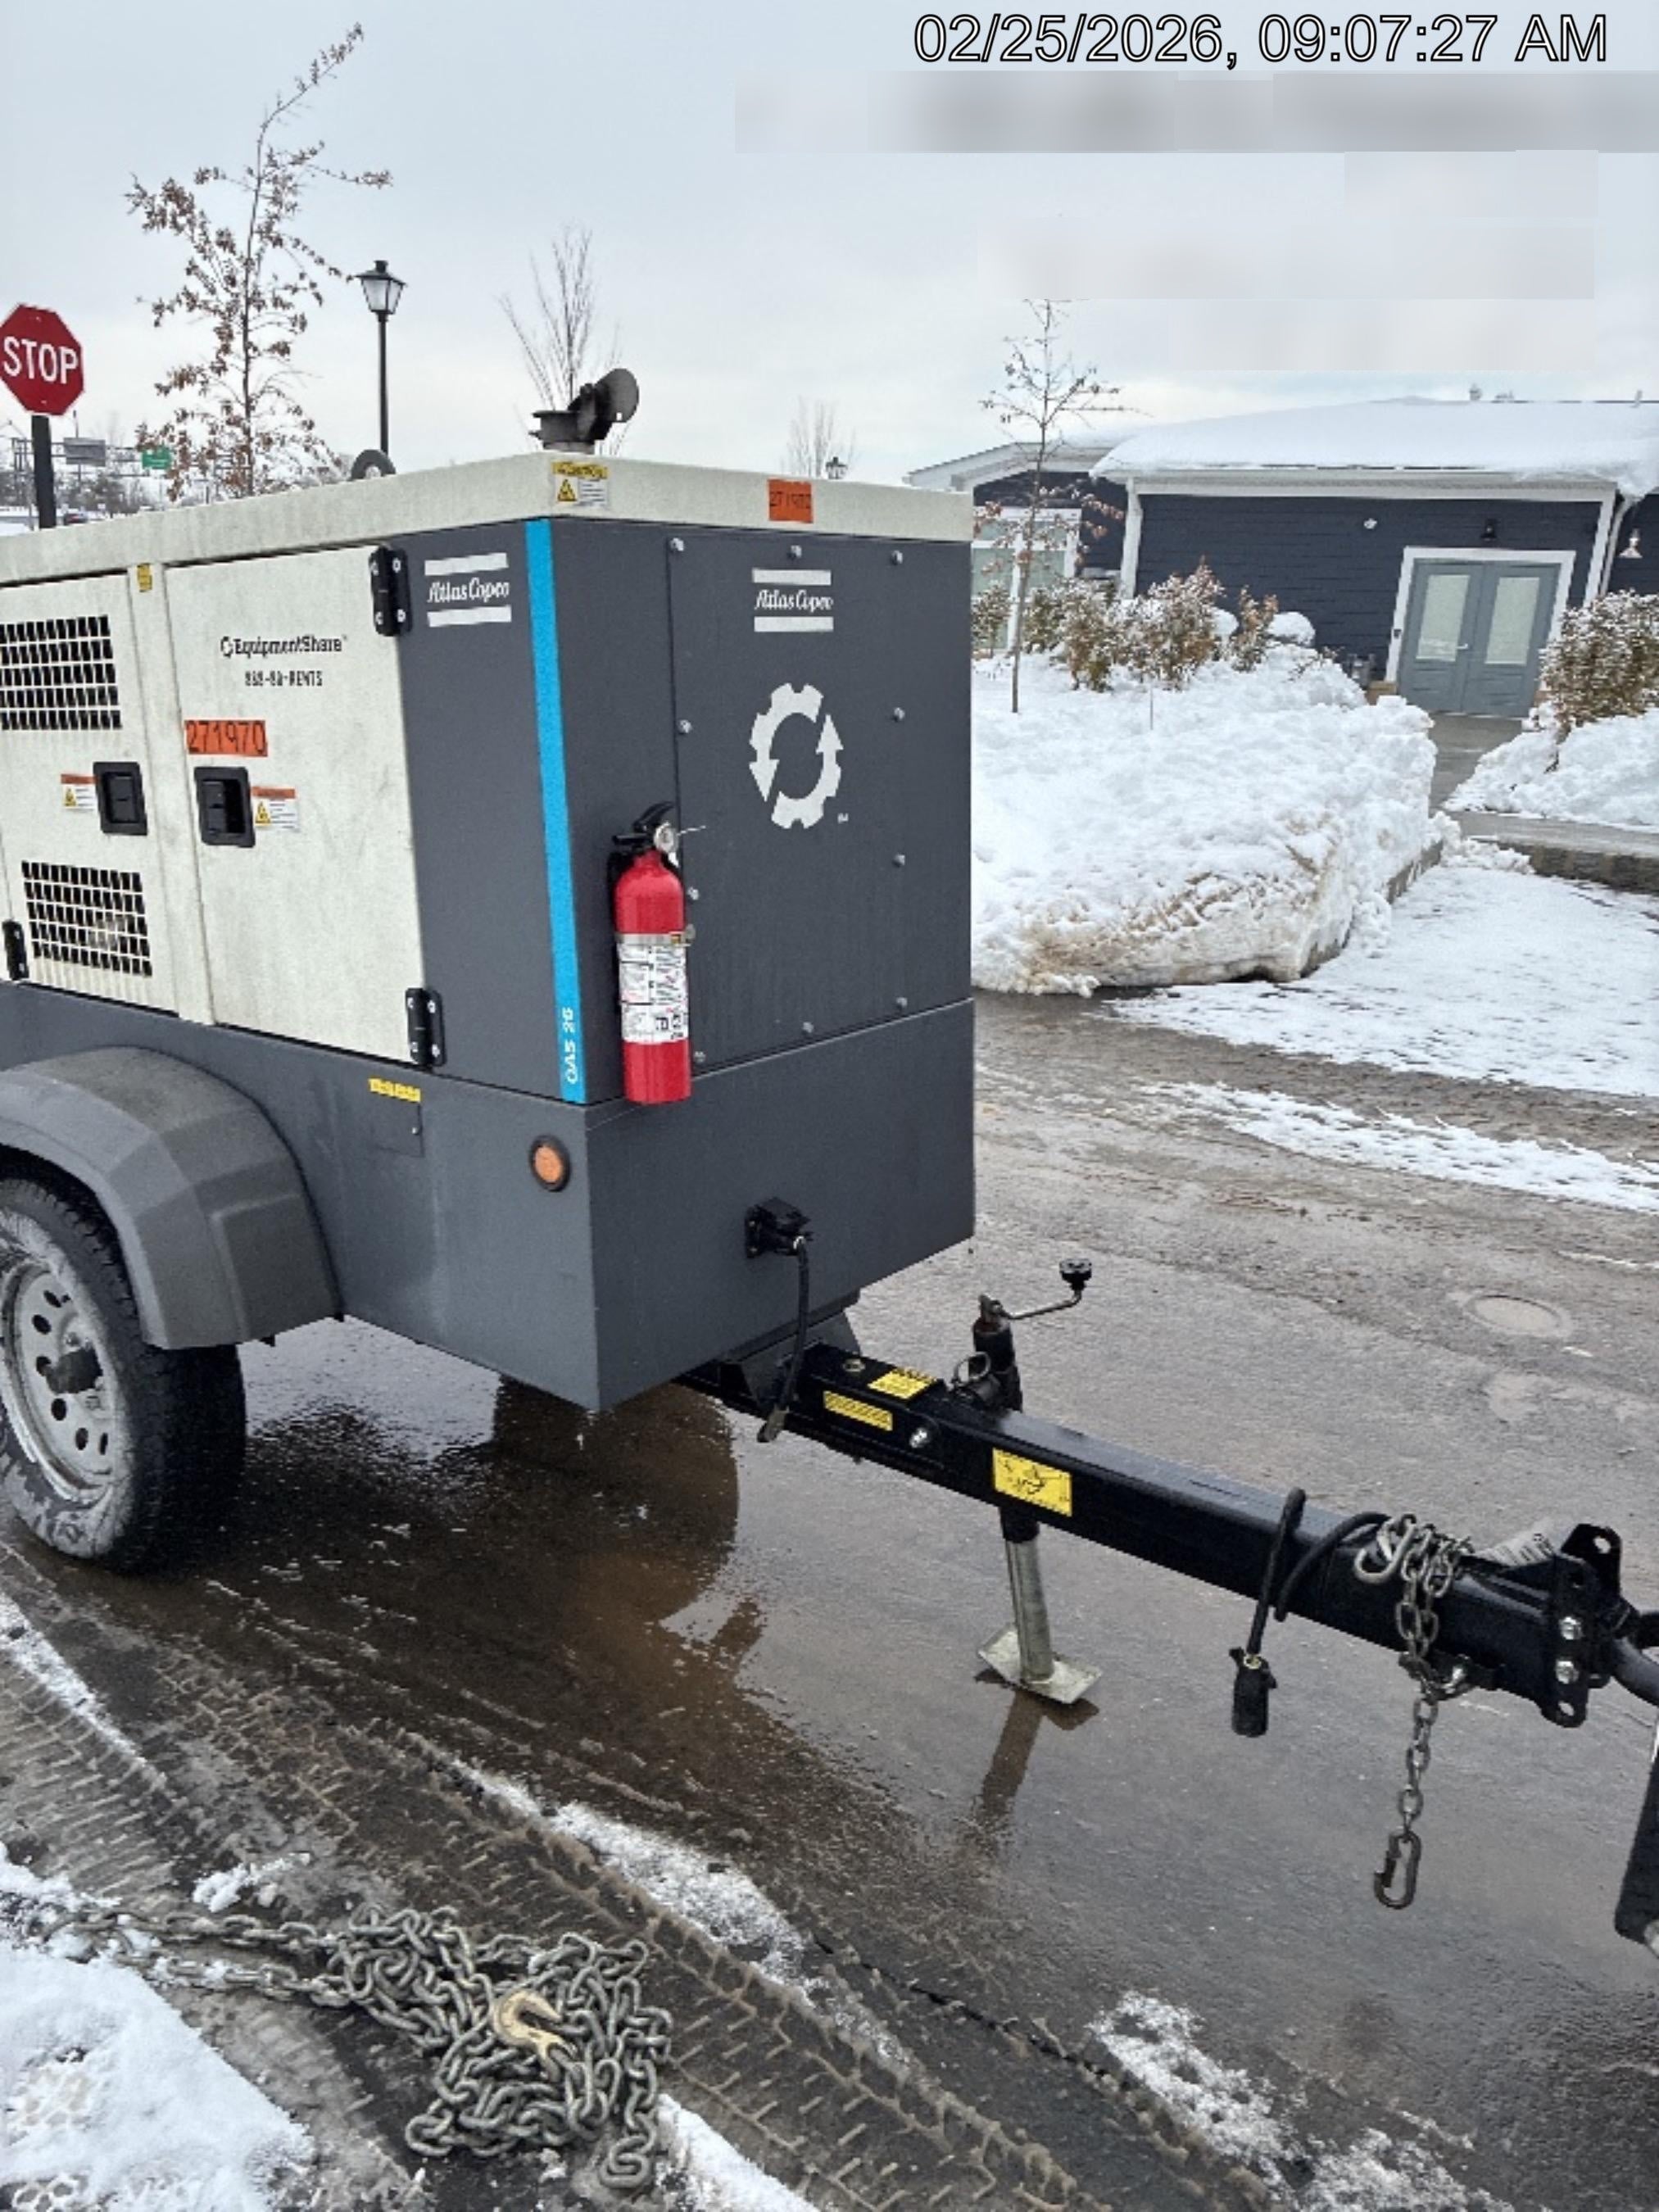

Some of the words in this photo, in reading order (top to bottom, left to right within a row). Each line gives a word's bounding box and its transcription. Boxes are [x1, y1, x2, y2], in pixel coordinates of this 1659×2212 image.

[3, 336, 78, 384] STOP
[427, 582, 468, 603] Atlas
[754, 589, 795, 610] Atlas
[186, 719, 266, 755] 271970
